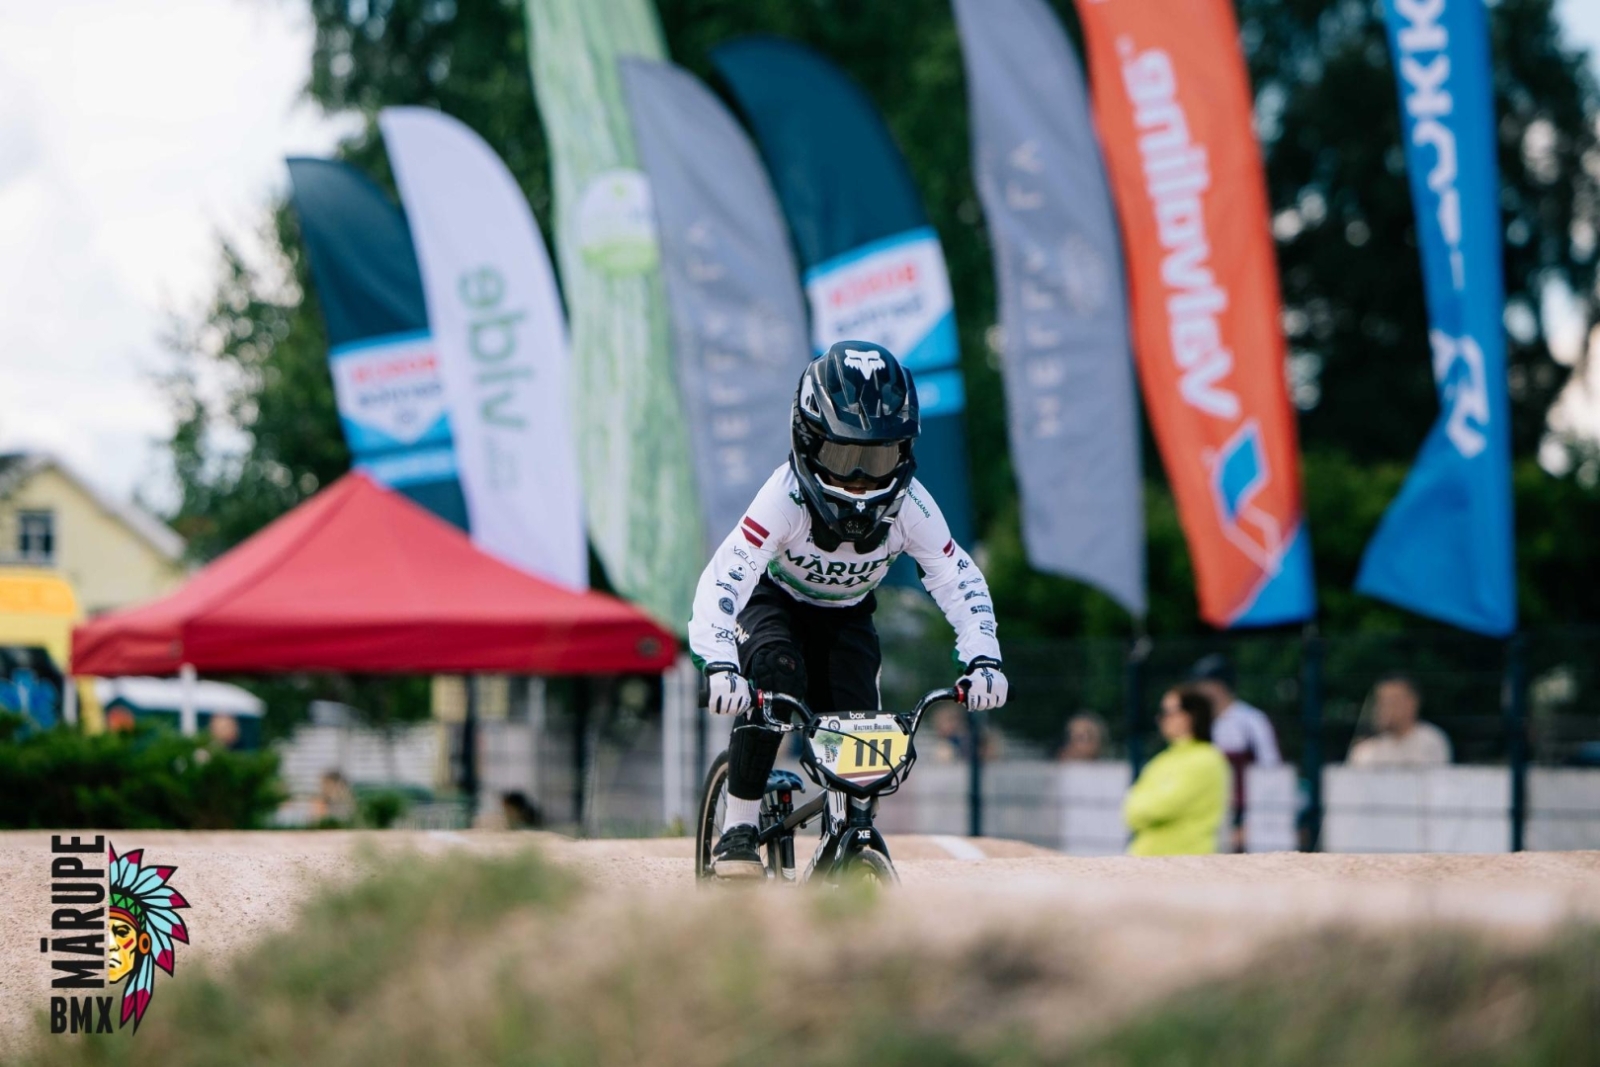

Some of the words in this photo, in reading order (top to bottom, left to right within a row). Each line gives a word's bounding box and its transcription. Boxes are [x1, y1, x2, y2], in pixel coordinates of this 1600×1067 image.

[804, 571, 874, 588] BMX
[854, 738, 892, 767] 111
[857, 830, 871, 839] XE
